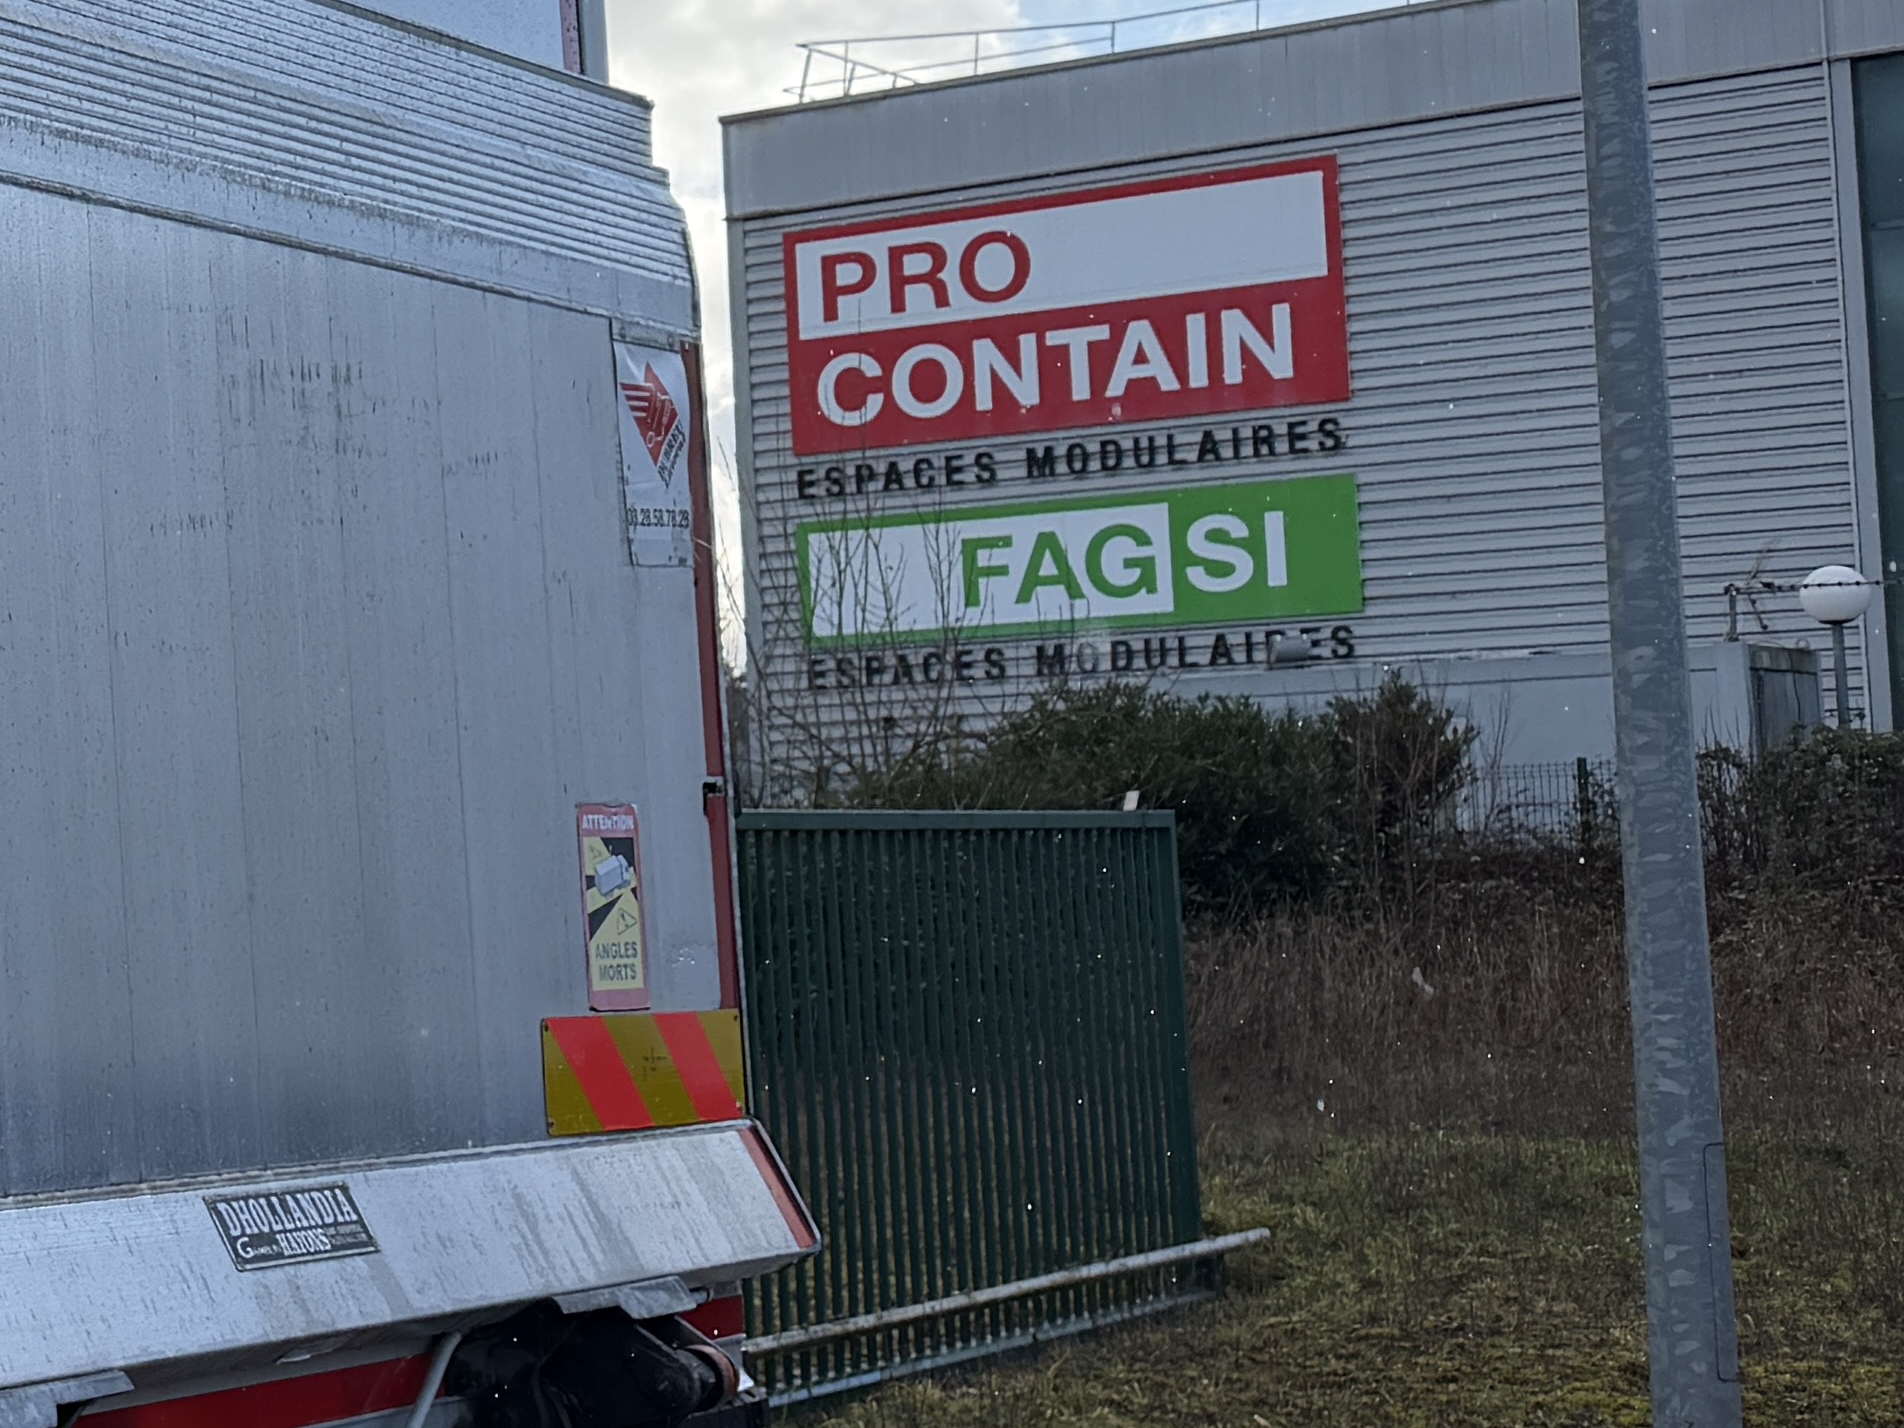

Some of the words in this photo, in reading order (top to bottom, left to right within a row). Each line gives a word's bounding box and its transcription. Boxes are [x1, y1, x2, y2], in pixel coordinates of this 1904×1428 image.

[819, 230, 1031, 323] PRO
[817, 303, 1294, 427] CONTAIN
[797, 452, 997, 500] ESPACES
[1026, 419, 1344, 478] MODULAIRES
[960, 511, 1288, 609] FAGSI
[809, 647, 1007, 690] ESPACES
[1036, 626, 1356, 675] MODULAIES
[595, 942, 638, 960] ANGLES
[598, 963, 637, 982] MORTS
[217, 1188, 358, 1237] DHOLLANDIA
